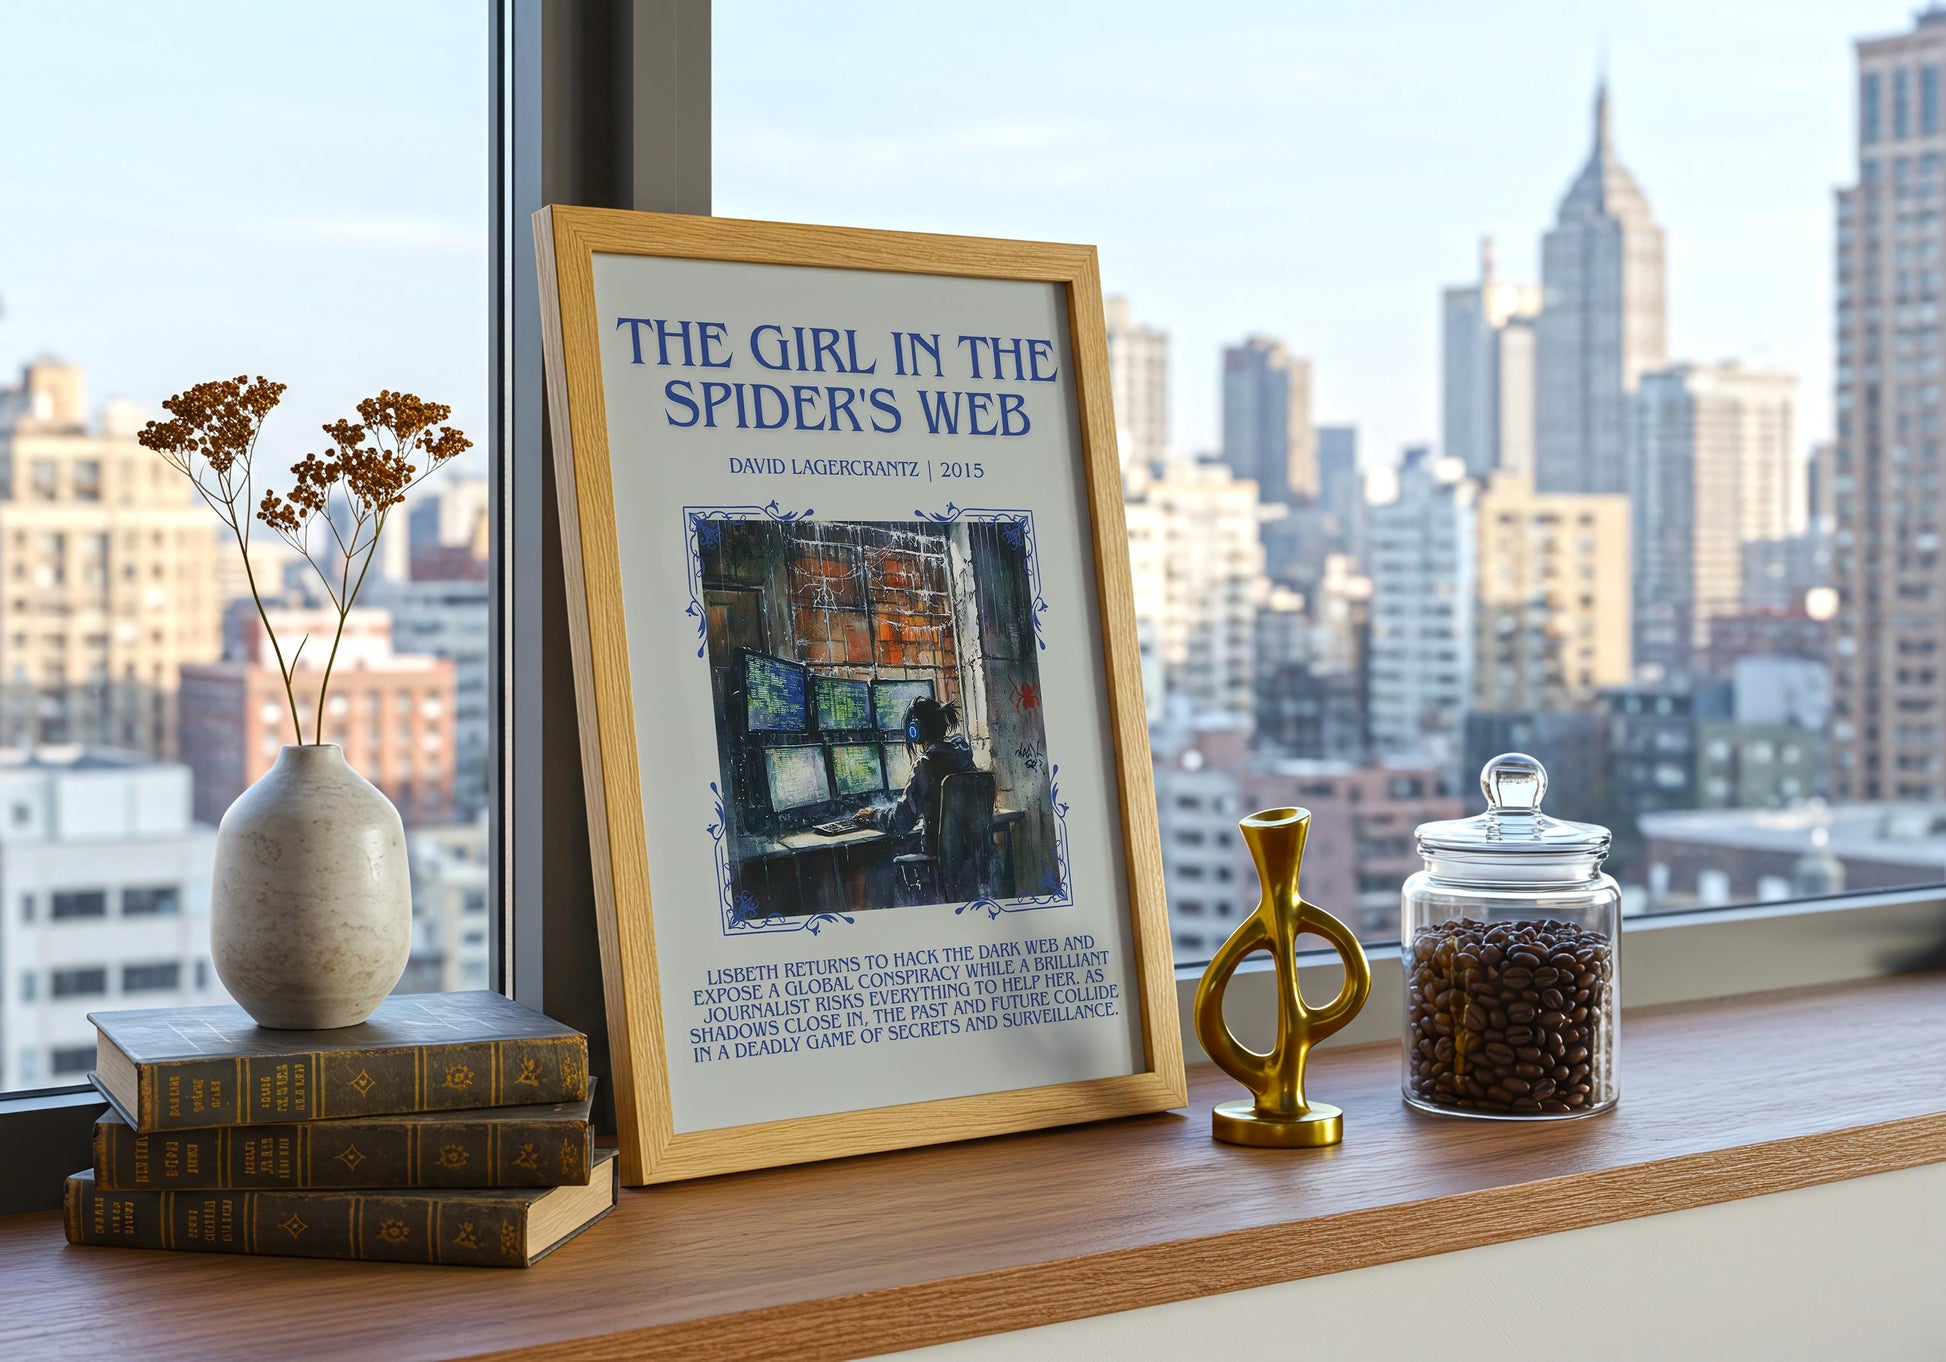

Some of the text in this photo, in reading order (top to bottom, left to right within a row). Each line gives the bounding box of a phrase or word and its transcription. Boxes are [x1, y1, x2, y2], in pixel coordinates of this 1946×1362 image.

[617, 317, 1058, 383] THE GIRL IN THE
[665, 380, 1031, 437] SPIDER'S WEB
[729, 458, 786, 474] DAVID
[792, 458, 919, 477] LAGERCRANTZ
[941, 462, 984, 478] 2015
[694, 950, 1109, 1006] EXPOSE A GLOBAL CONSPIRACY WHILE A BRILLIANT
[707, 934, 1095, 986] LISBETH RETURNS TO HACK THE DARK WEB AND
[690, 983, 1119, 1044] SHADOWS CLOSE IN, THE PAST AND FUTURE COLLIDE
[703, 968, 1104, 1024] JOURNALIST RISKS EVERYTHING TO HELP HER. AS
[694, 1002, 1118, 1063] IN A DEADLY GAME OF SECRETS AND SURVEILLANCE.
